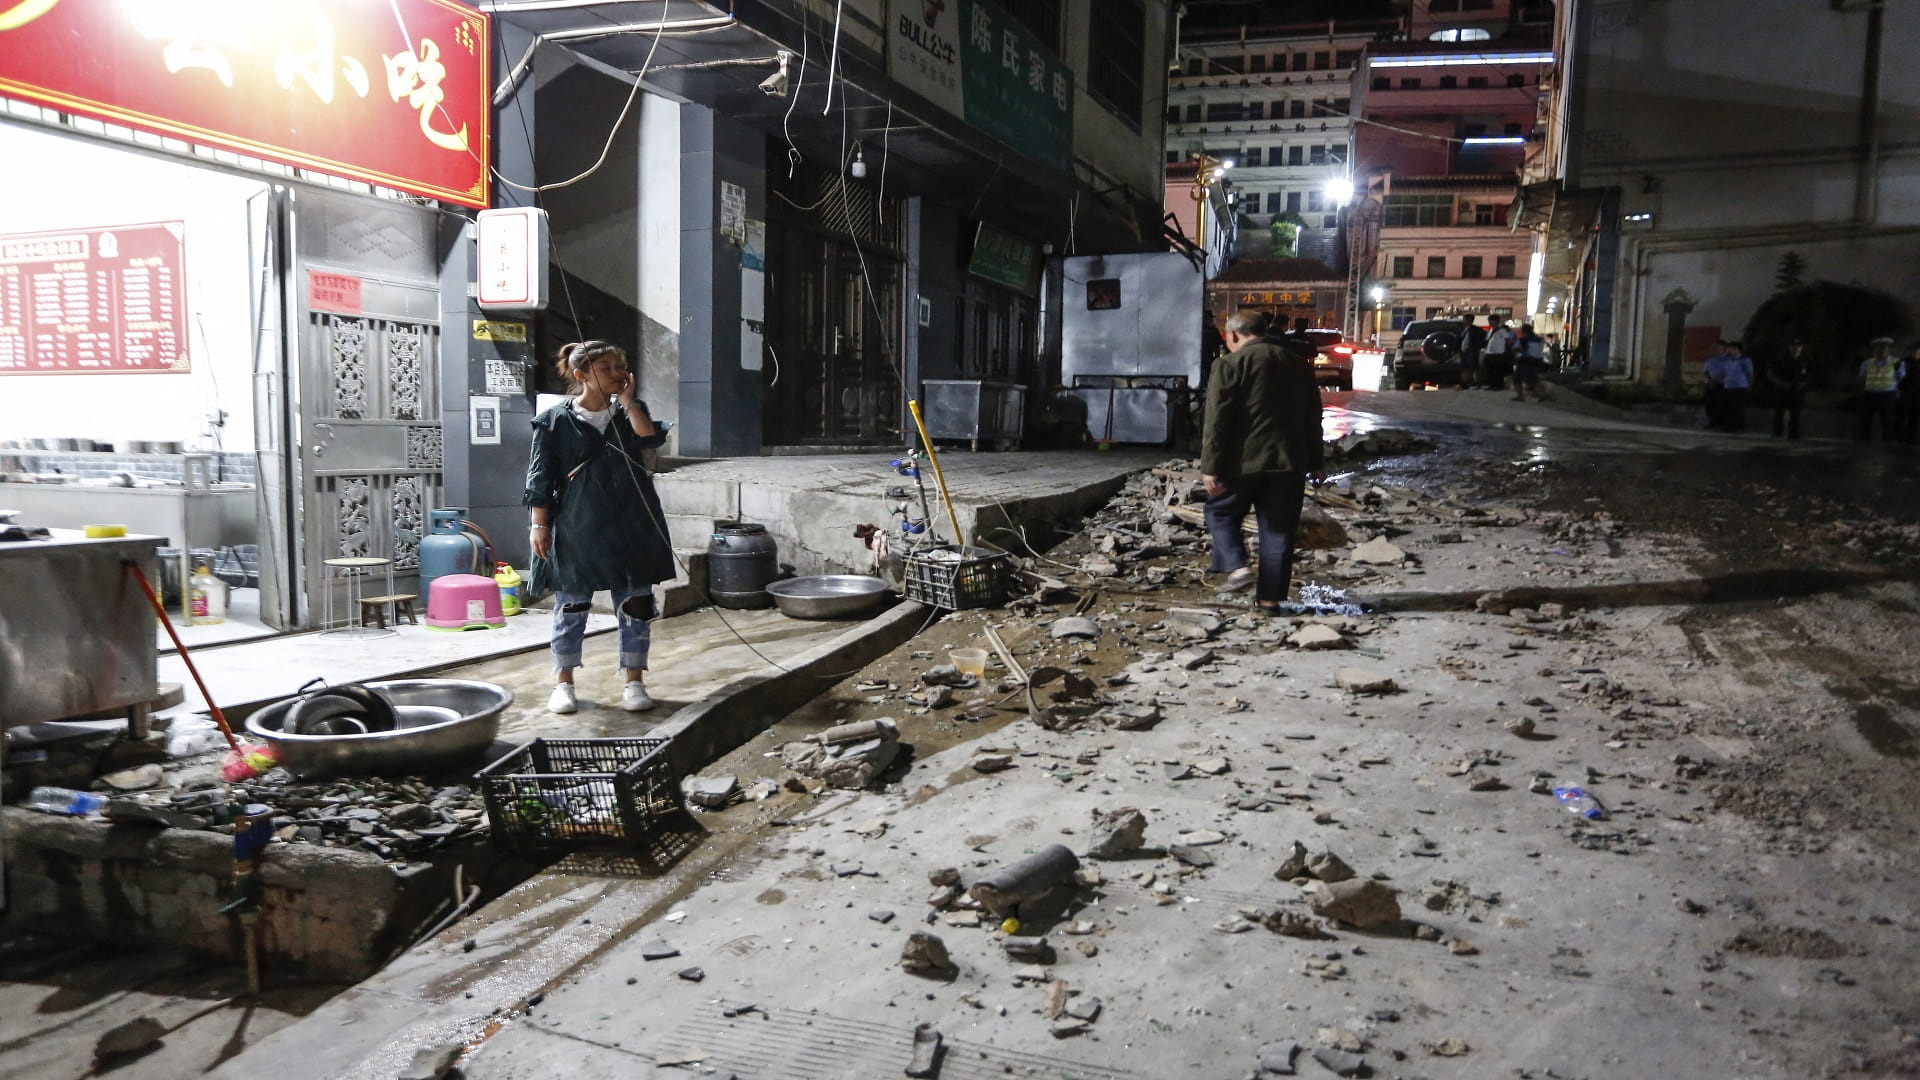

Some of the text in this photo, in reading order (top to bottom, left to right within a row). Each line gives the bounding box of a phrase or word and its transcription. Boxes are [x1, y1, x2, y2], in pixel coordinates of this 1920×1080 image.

[971, 1, 1067, 113] 陈氏家电
[1243, 290, 1311, 304] 小河中学
